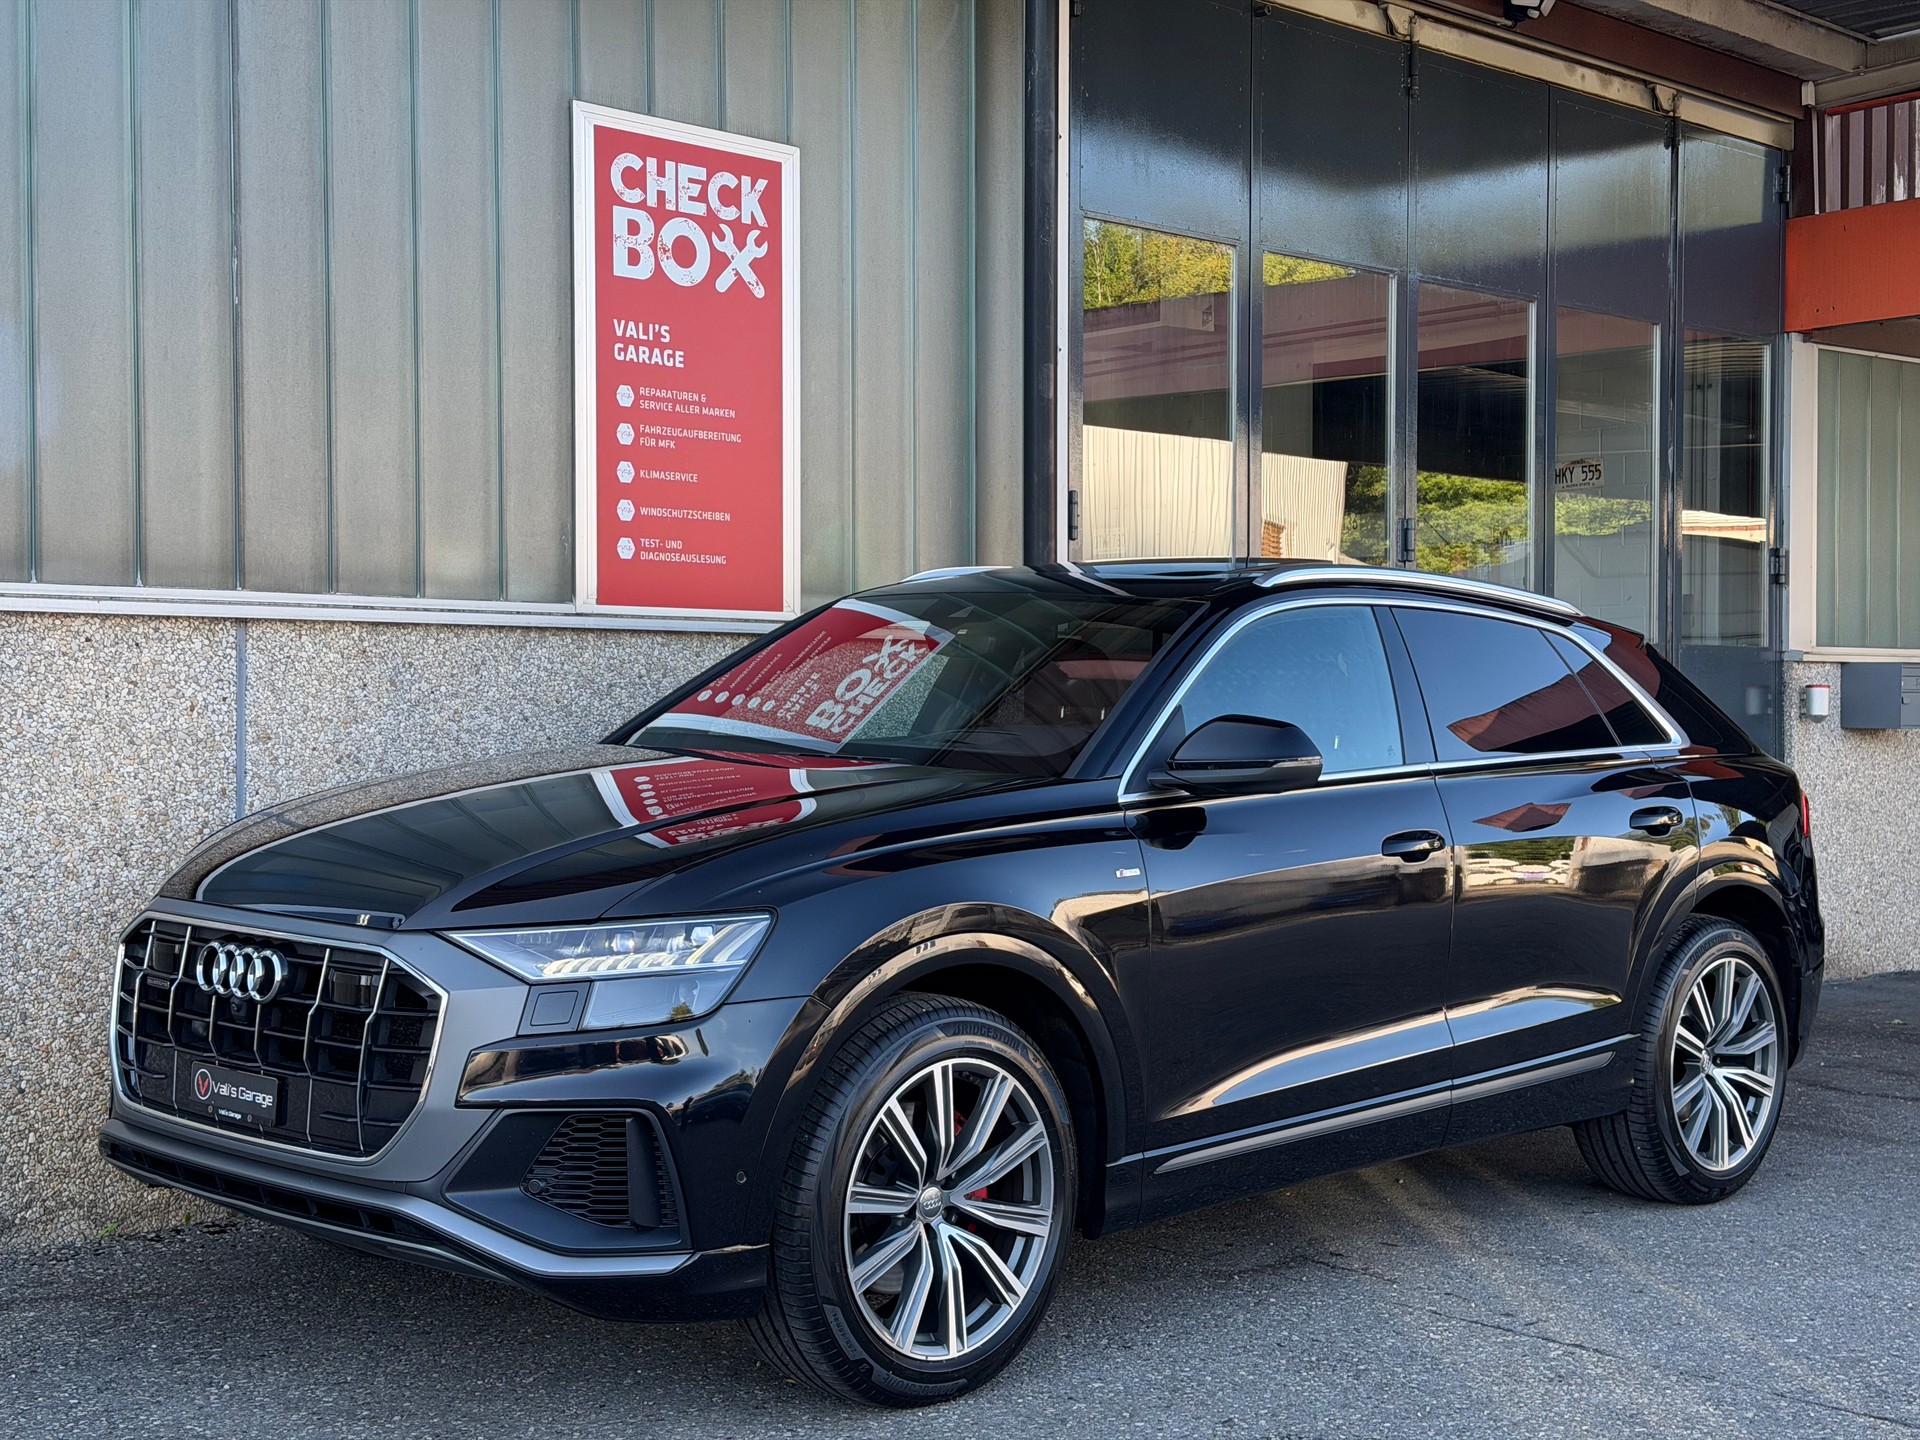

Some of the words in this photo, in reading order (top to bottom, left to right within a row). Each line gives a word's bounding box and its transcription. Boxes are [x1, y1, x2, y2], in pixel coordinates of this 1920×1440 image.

[610, 152, 768, 228] CHECK
[612, 205, 768, 299] BOX
[613, 318, 671, 343] VALI'S
[613, 342, 685, 368] GARAGE
[639, 386, 699, 402] REPARATUREN
[700, 393, 707, 402] &
[639, 399, 673, 412] SERVICE
[675, 403, 700, 415] ALLER
[702, 406, 736, 419] MARKEN
[639, 424, 742, 443] FAHRZEUGAUFBEREITUNG
[639, 436, 656, 447] FÜR
[658, 439, 676, 449] MFK
[639, 469, 699, 483] KLIMASERVICE
[1554, 466, 1575, 485] HKY
[1581, 463, 1602, 482] 555
[639, 506, 731, 522] WINDSCHUTZSCHEIBEN
[639, 538, 664, 549] TEST-
[665, 540, 683, 550] UND
[640, 550, 727, 565] DIAGNOSEAUSLESUNG
[952, 1021, 1023, 1055] BRIDGESTONE
[212, 1080, 237, 1098] Vali's
[238, 1086, 273, 1108] Garage
